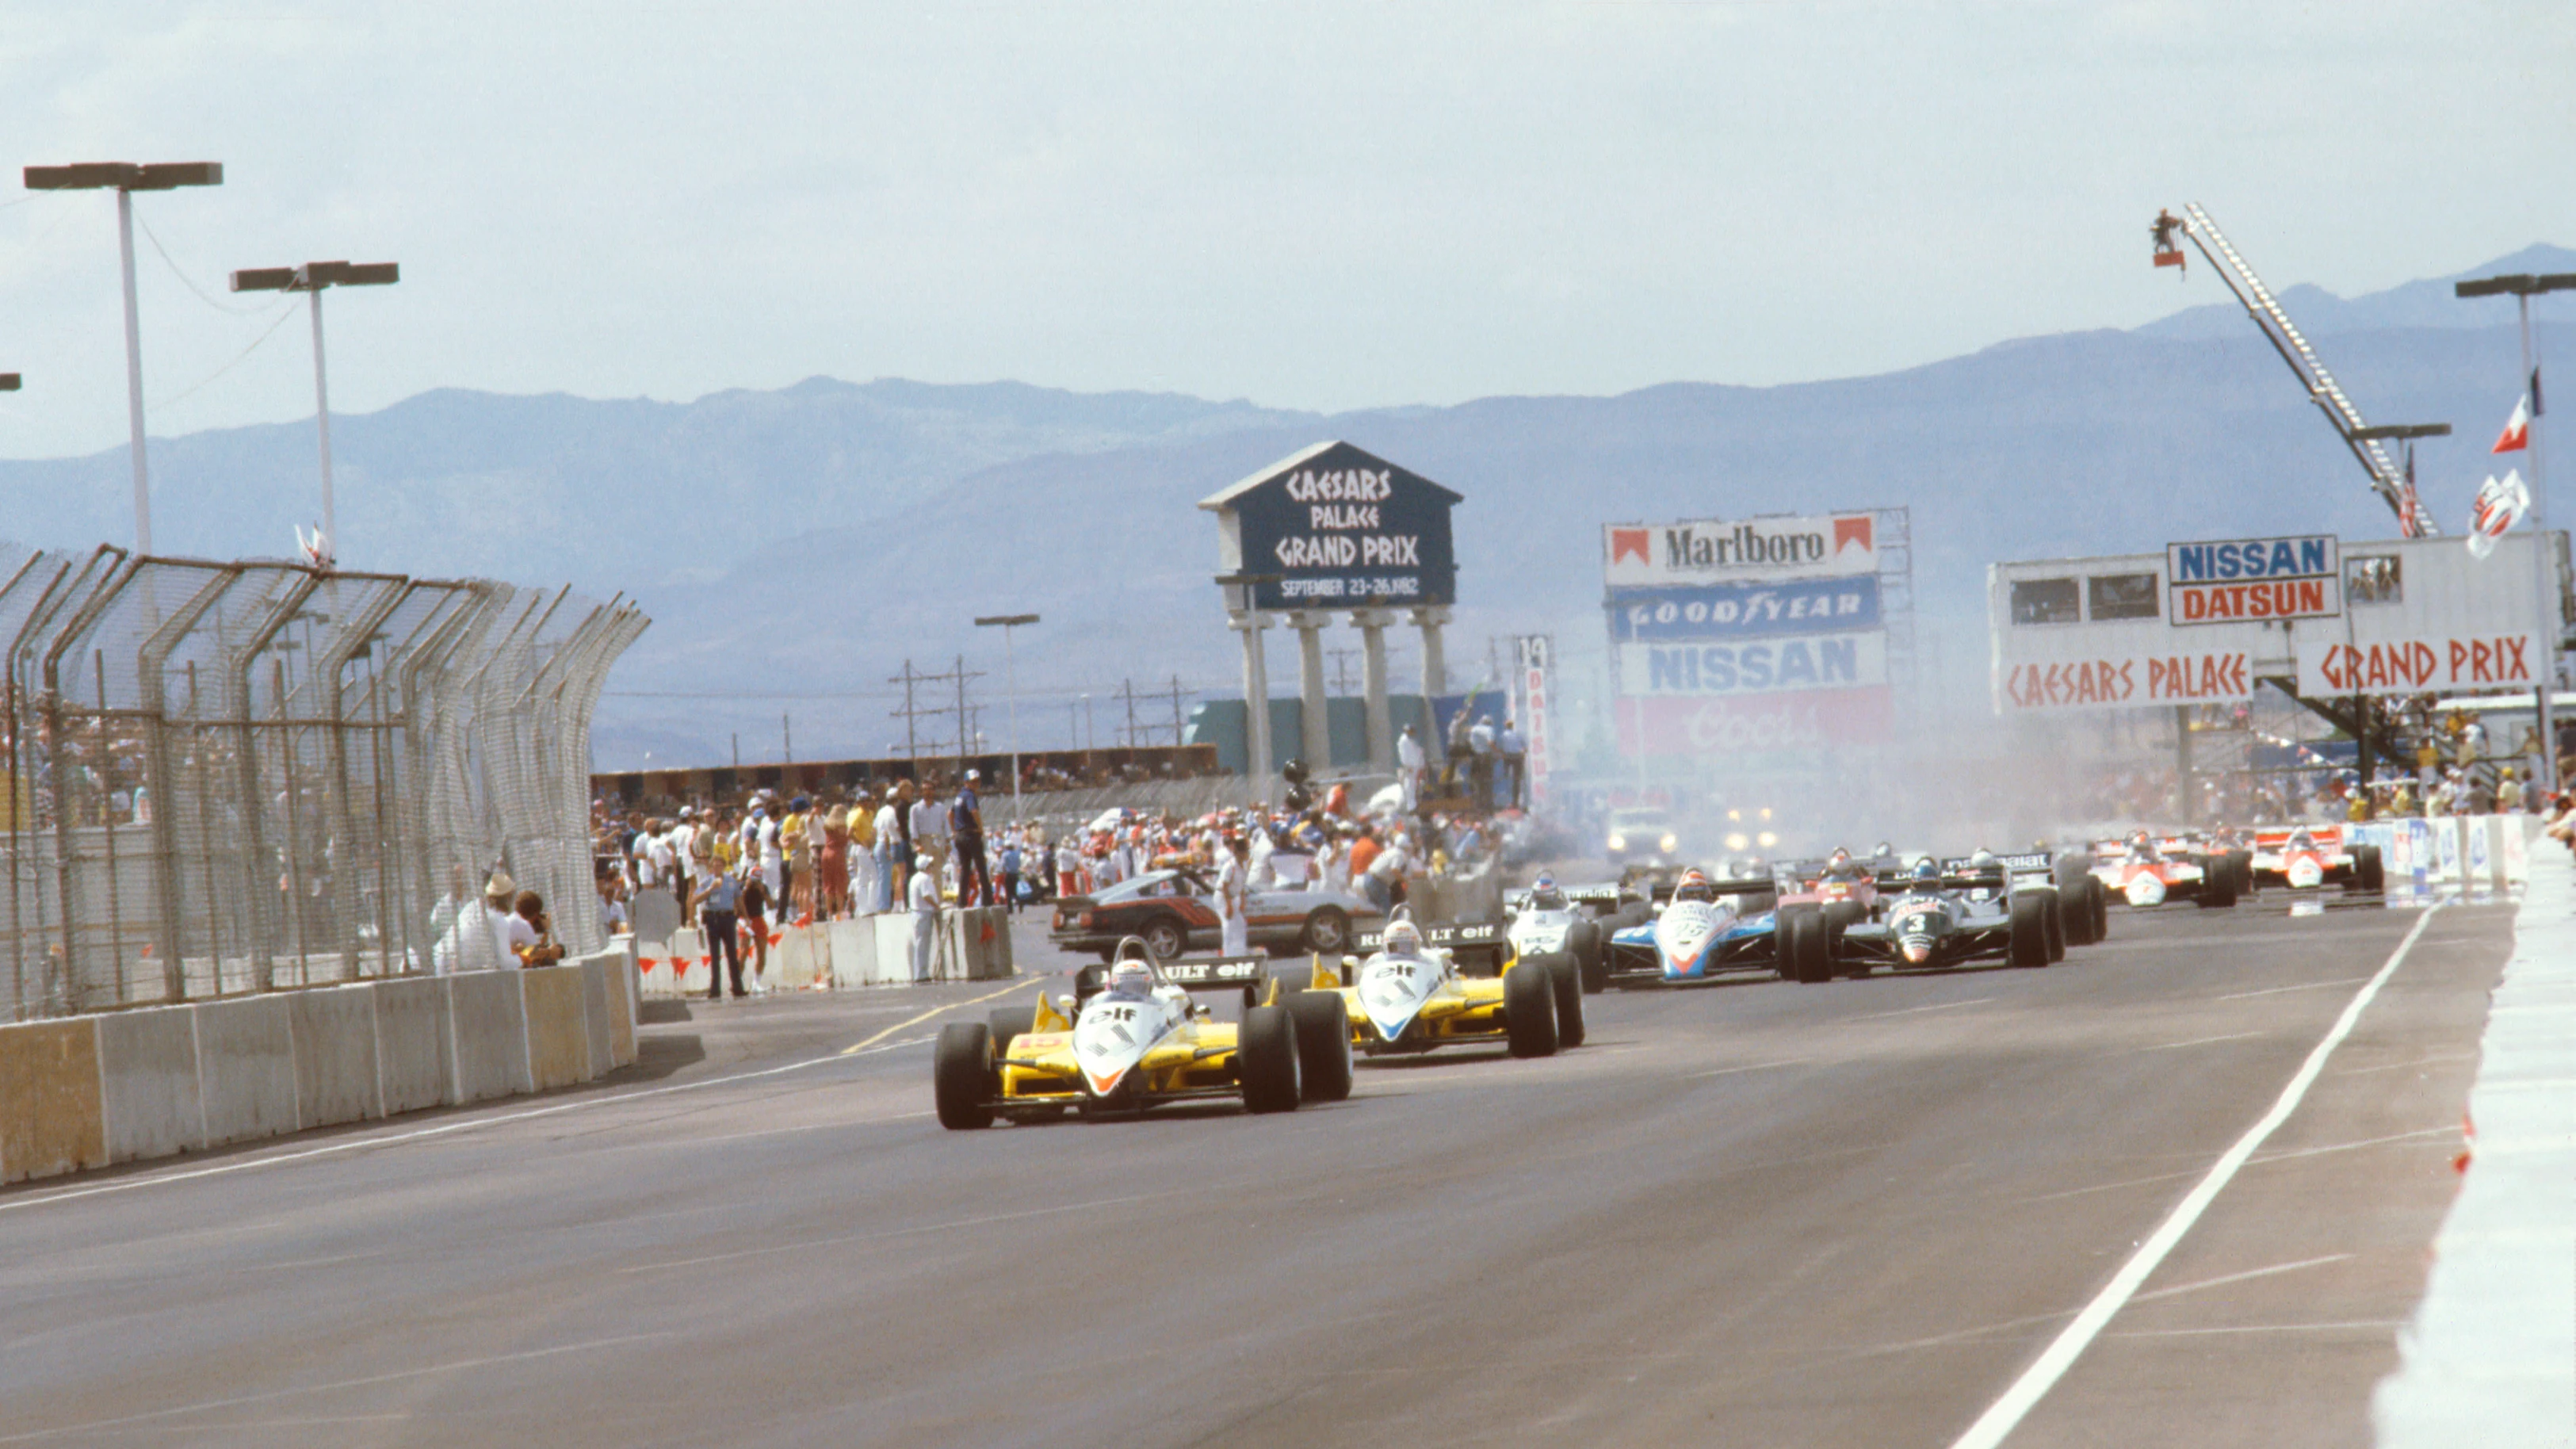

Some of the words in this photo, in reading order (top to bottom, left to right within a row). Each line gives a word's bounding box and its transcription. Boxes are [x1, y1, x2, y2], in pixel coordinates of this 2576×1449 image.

[1286, 468, 1392, 502] CAESARS
[1311, 504, 1380, 530] PALACE
[1276, 535, 1356, 568] GRAND
[1363, 534, 1420, 566] PRIX
[1666, 524, 1825, 568] Marlboro
[2178, 539, 2326, 581] NISSAN
[1281, 579, 1344, 597] SEPTEMBER
[2183, 580, 2325, 620] DATSUN
[1648, 637, 1856, 690] NISSAN
[2006, 658, 2135, 708] CAESARS
[2149, 652, 2248, 699] PALACE
[2321, 642, 2437, 690] GRAND
[2450, 636, 2530, 683] PRIX
[1461, 925, 1494, 939] elf
[1907, 914, 1926, 932] 3
[1216, 962, 1256, 977] elf
[1375, 964, 1416, 979] elf
[1088, 1007, 1137, 1025] elf
